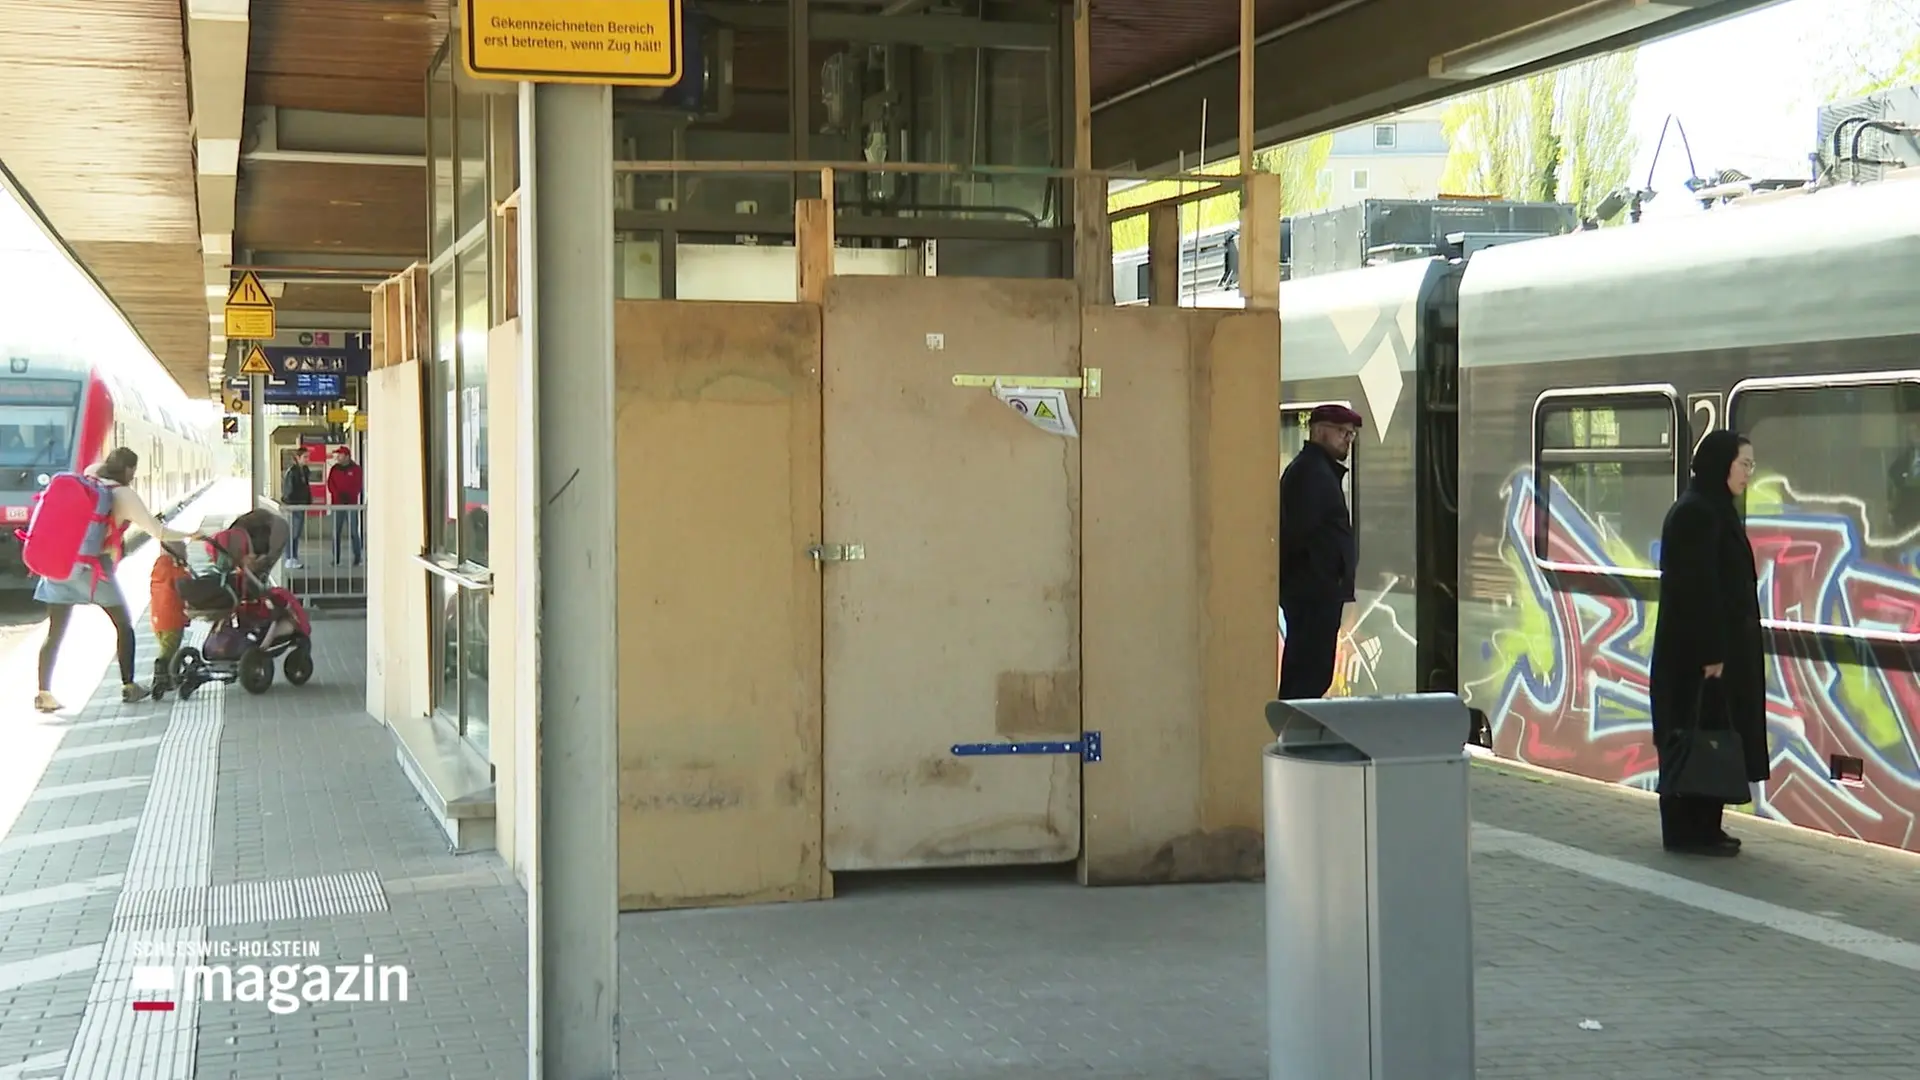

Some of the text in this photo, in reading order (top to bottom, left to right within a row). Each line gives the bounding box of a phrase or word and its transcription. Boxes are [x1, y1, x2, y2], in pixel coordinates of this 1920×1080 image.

[491, 16, 655, 35] Gekennzeichneten Bereich
[484, 35, 662, 54] erst betreten, wenn Zug hält!
[1692, 399, 1716, 468] 2
